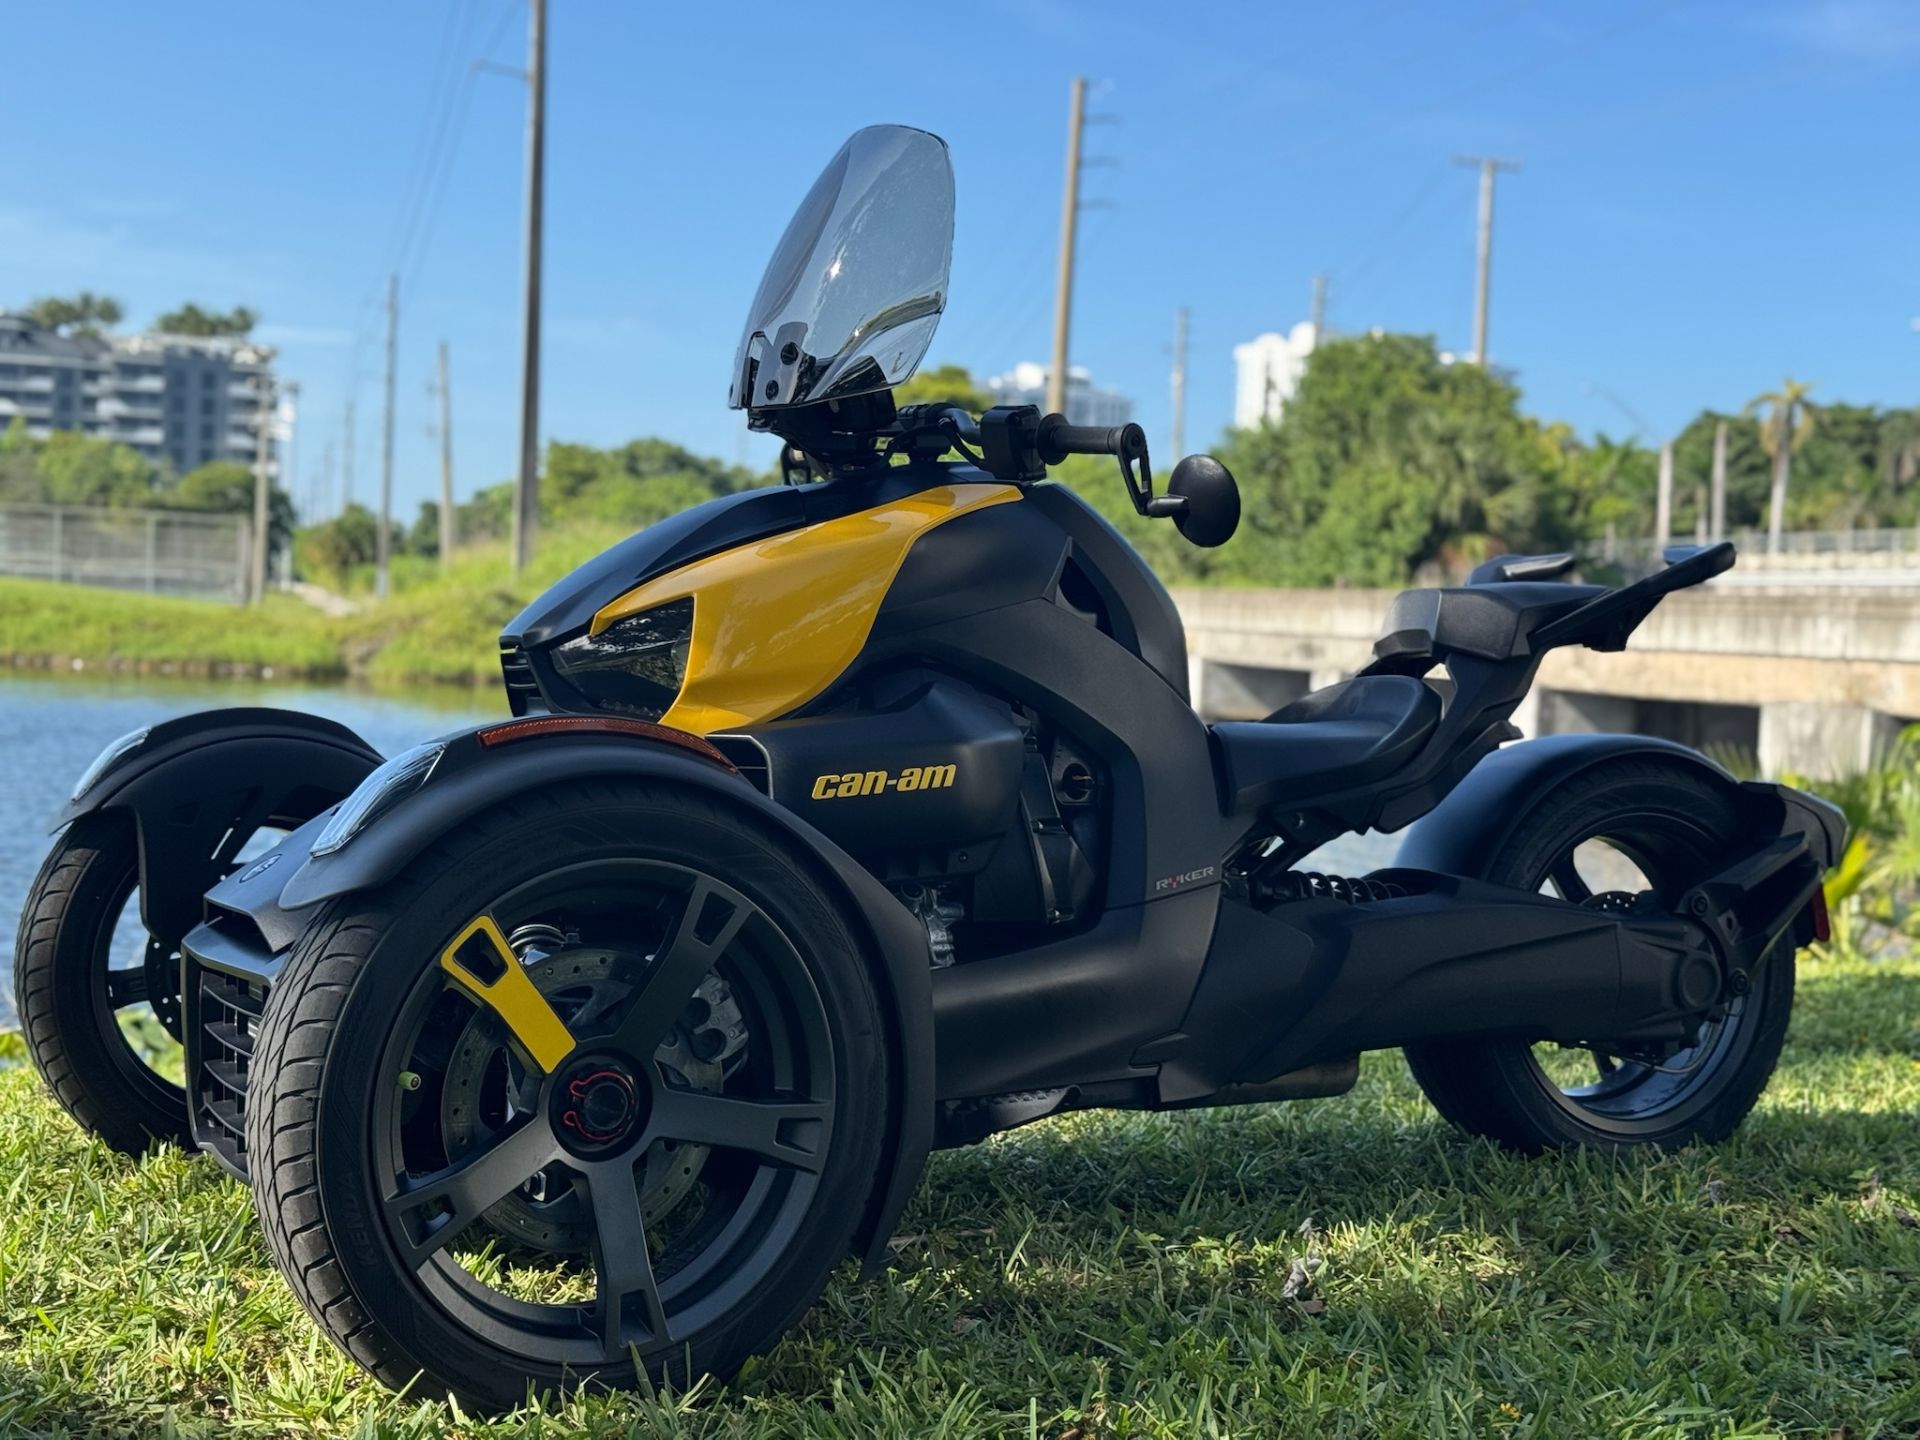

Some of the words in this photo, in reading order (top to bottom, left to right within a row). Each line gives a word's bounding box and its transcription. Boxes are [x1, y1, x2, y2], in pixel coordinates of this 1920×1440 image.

[811, 763, 957, 800] can-am
[1155, 866, 1215, 891] RYKER
[338, 1171, 377, 1266] KENDA
